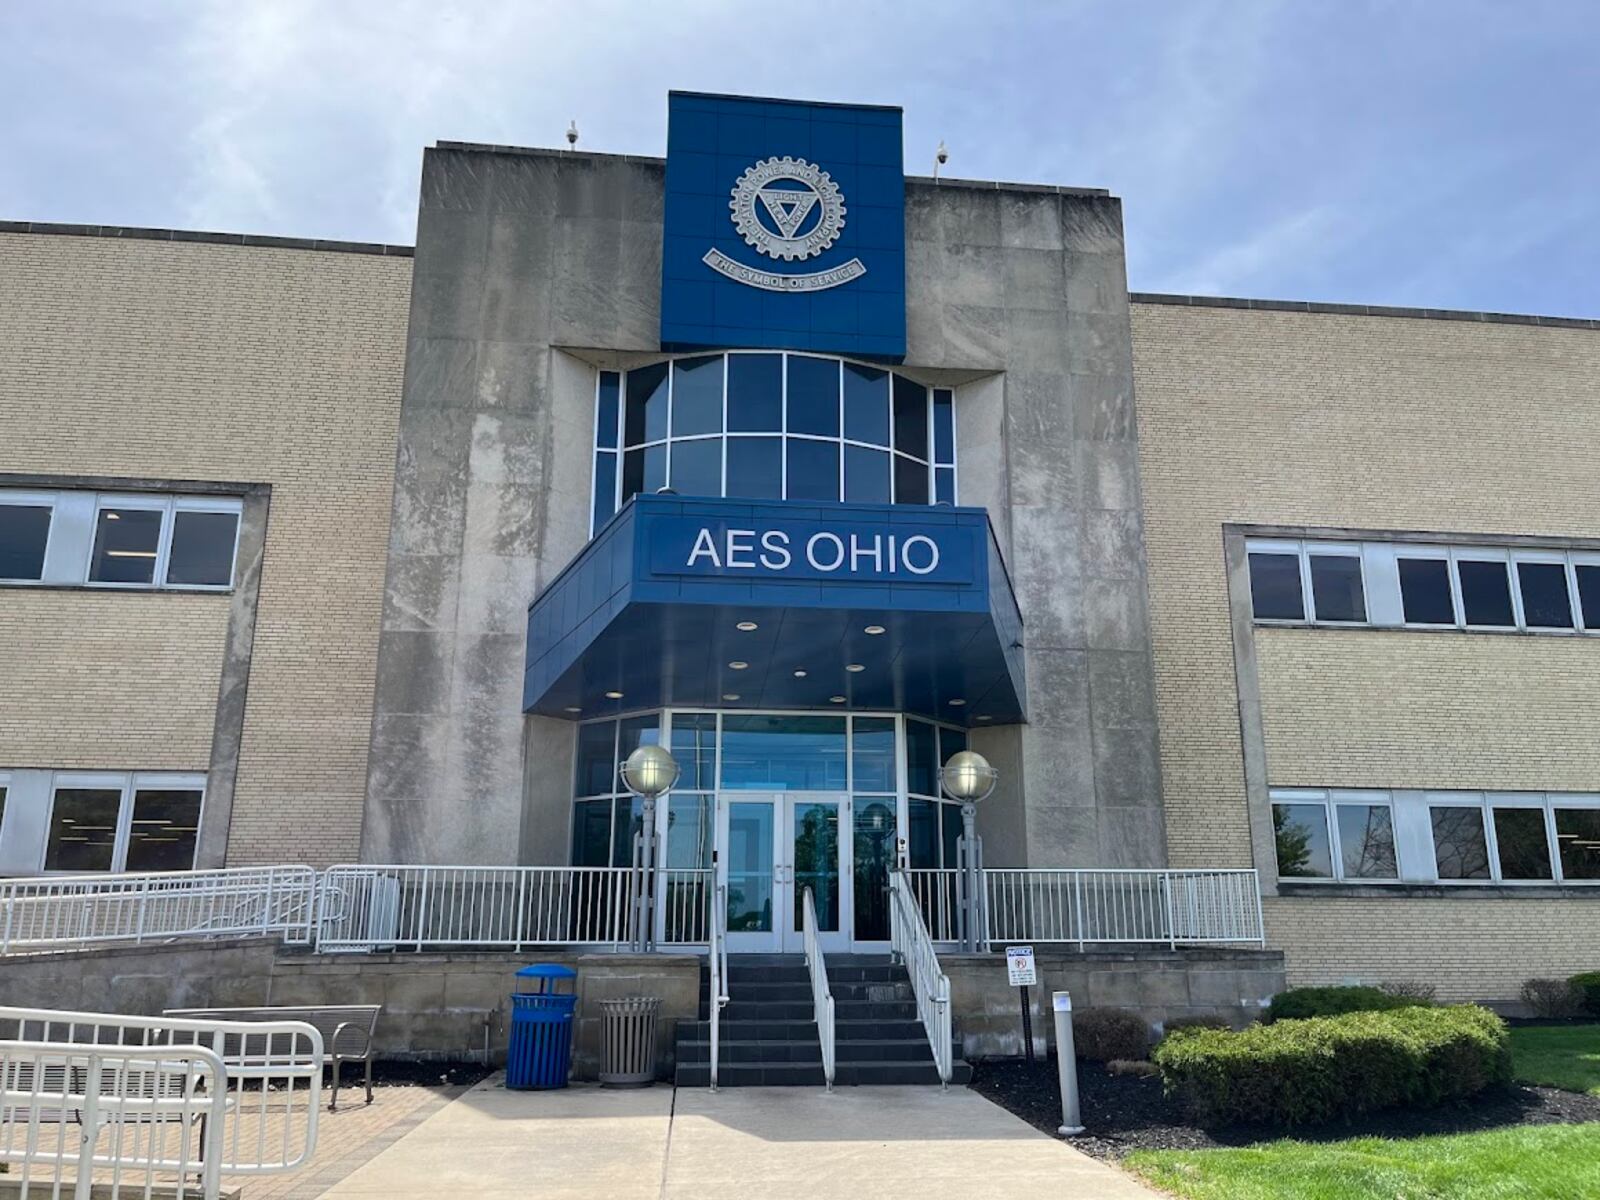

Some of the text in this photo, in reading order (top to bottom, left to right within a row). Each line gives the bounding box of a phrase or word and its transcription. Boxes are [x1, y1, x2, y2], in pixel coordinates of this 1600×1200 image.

[751, 166, 787, 186] POWER
[790, 166, 812, 179] AND
[774, 193, 803, 201] LIGHT
[813, 176, 834, 206] LIGHT
[806, 207, 835, 248] COMPANY
[715, 257, 857, 288] THE SYMBOL OF SERVICE
[686, 528, 939, 574] AES OHIO
